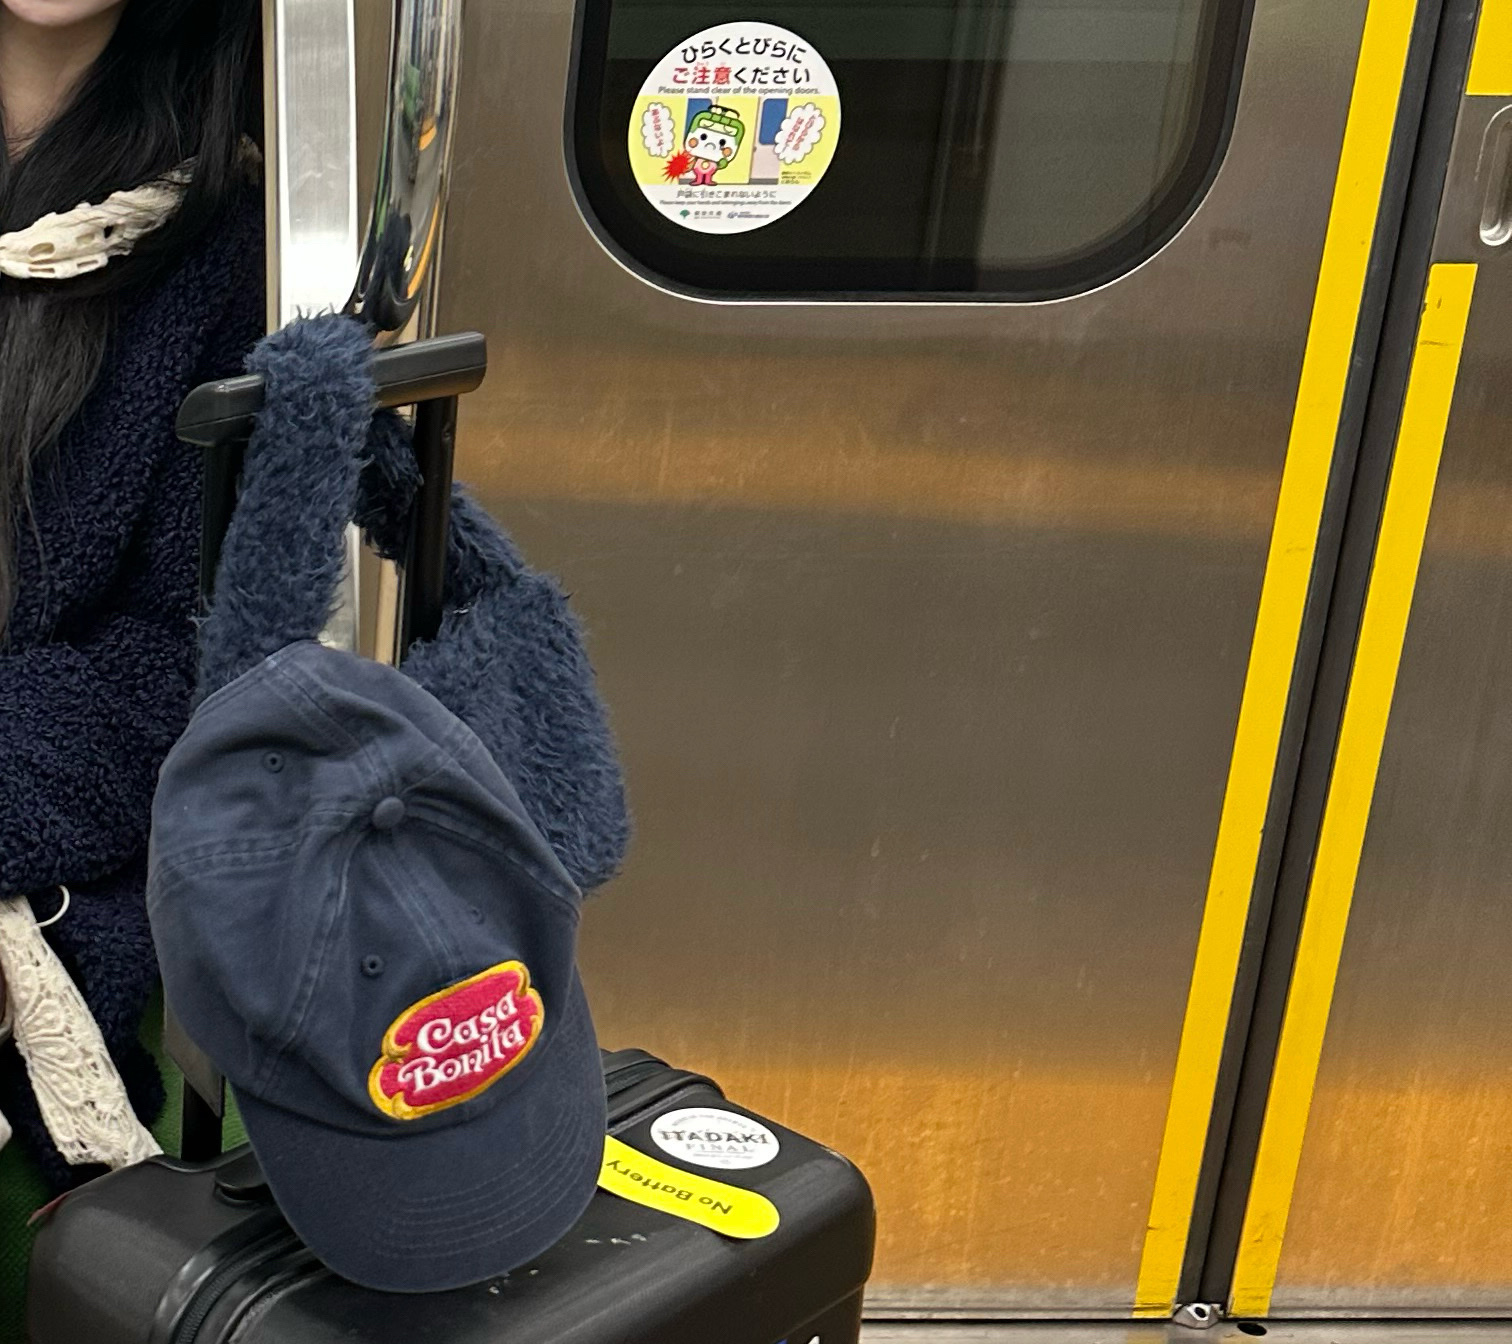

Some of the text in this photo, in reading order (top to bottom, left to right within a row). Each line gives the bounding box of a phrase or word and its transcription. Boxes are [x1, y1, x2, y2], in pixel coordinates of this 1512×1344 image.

[681, 36, 807, 64] ひらくとびらに
[672, 66, 811, 85] ご注意ください
[658, 85, 821, 96] Please stand clear of the opening doors.
[417, 990, 518, 1054] Casa
[397, 1019, 526, 1093] Bonita
[659, 1129, 770, 1144] ITADAKI
[606, 1159, 733, 1215] No Battery
